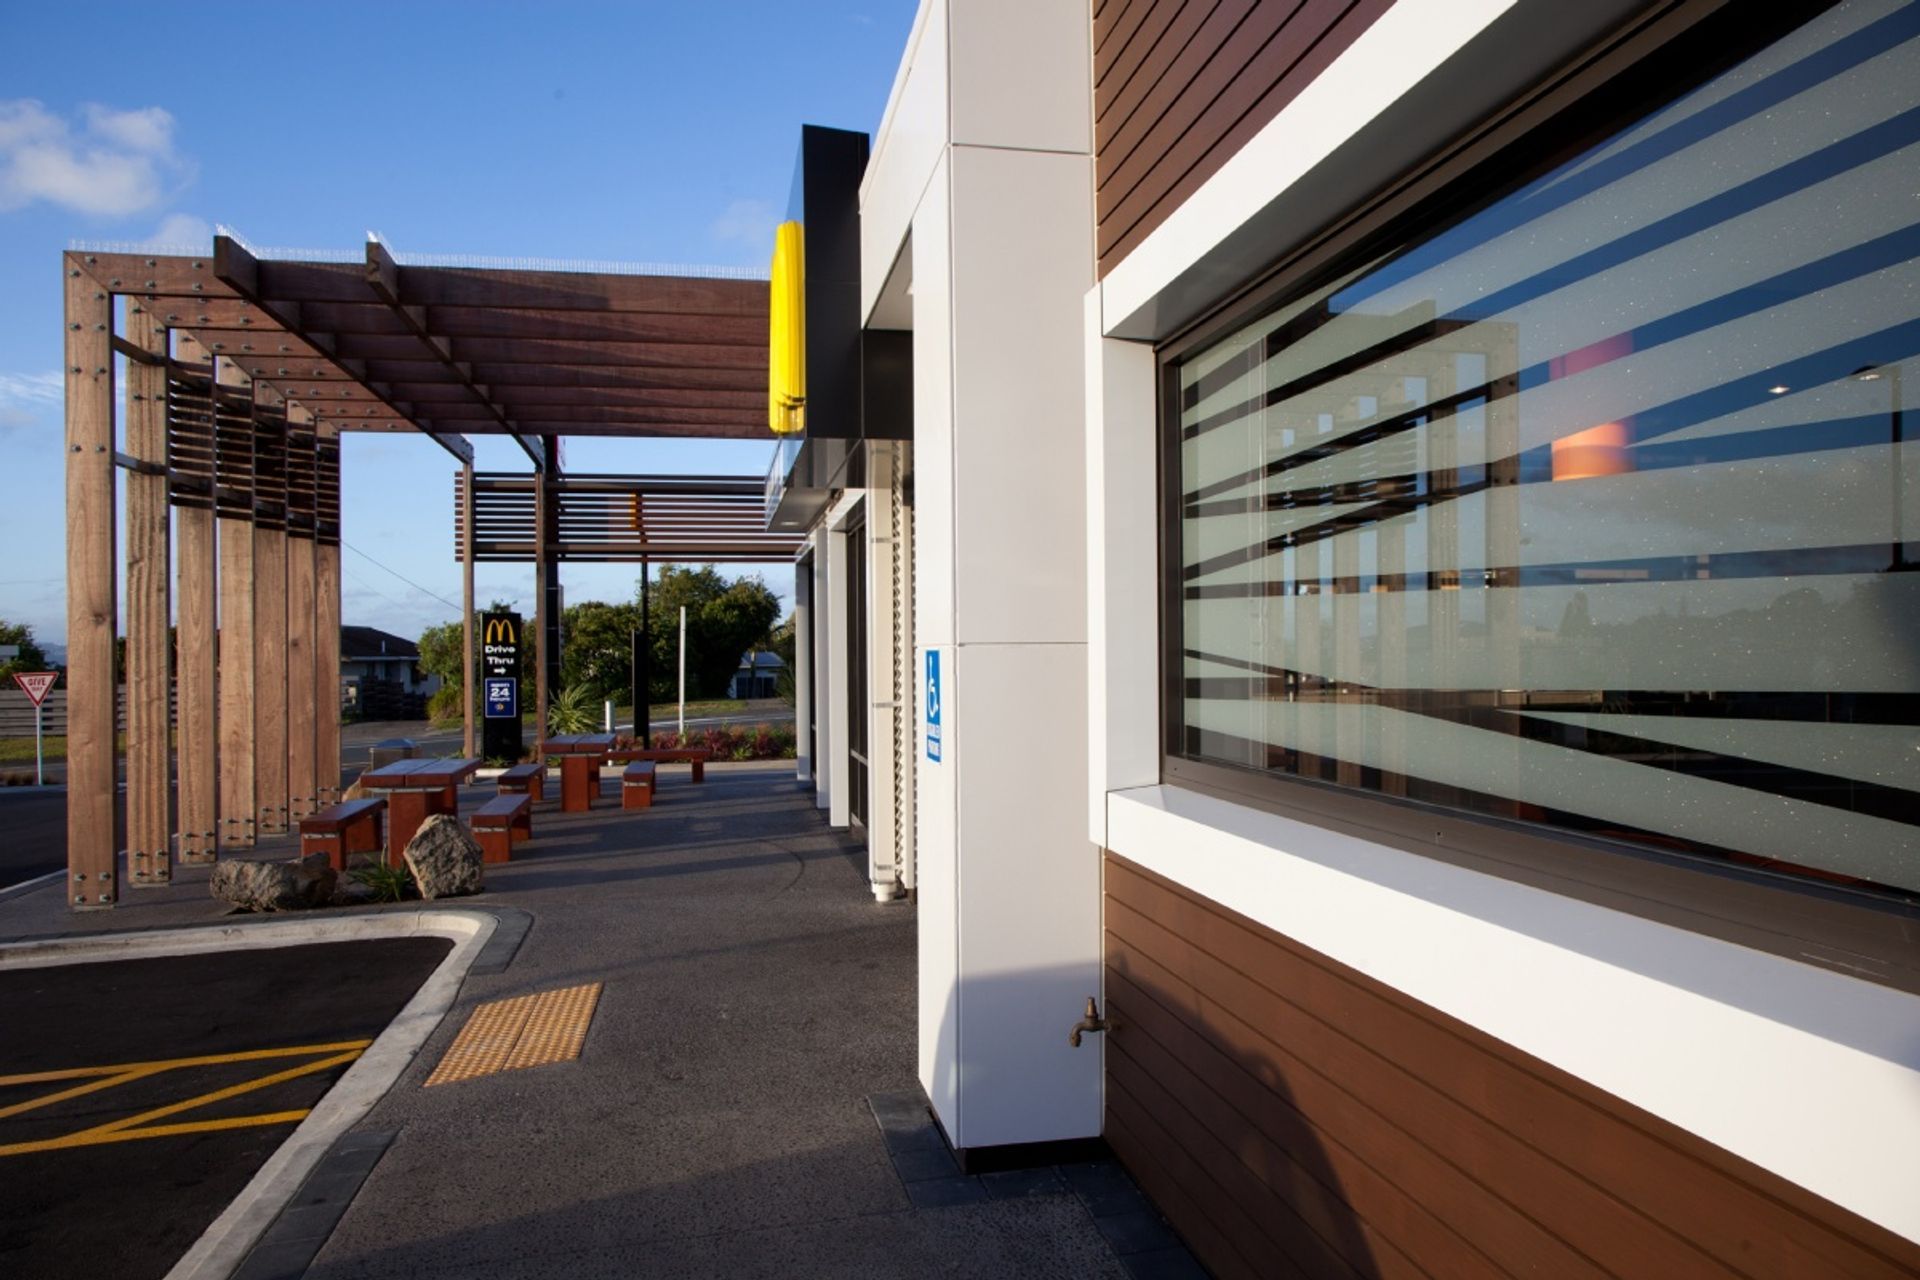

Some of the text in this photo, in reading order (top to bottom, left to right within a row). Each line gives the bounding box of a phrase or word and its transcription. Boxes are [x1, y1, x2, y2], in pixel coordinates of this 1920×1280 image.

[485, 645, 516, 654] Drive
[487, 656, 515, 665] Thru
[28, 678, 46, 686] GIVE
[491, 687, 510, 697] 24
